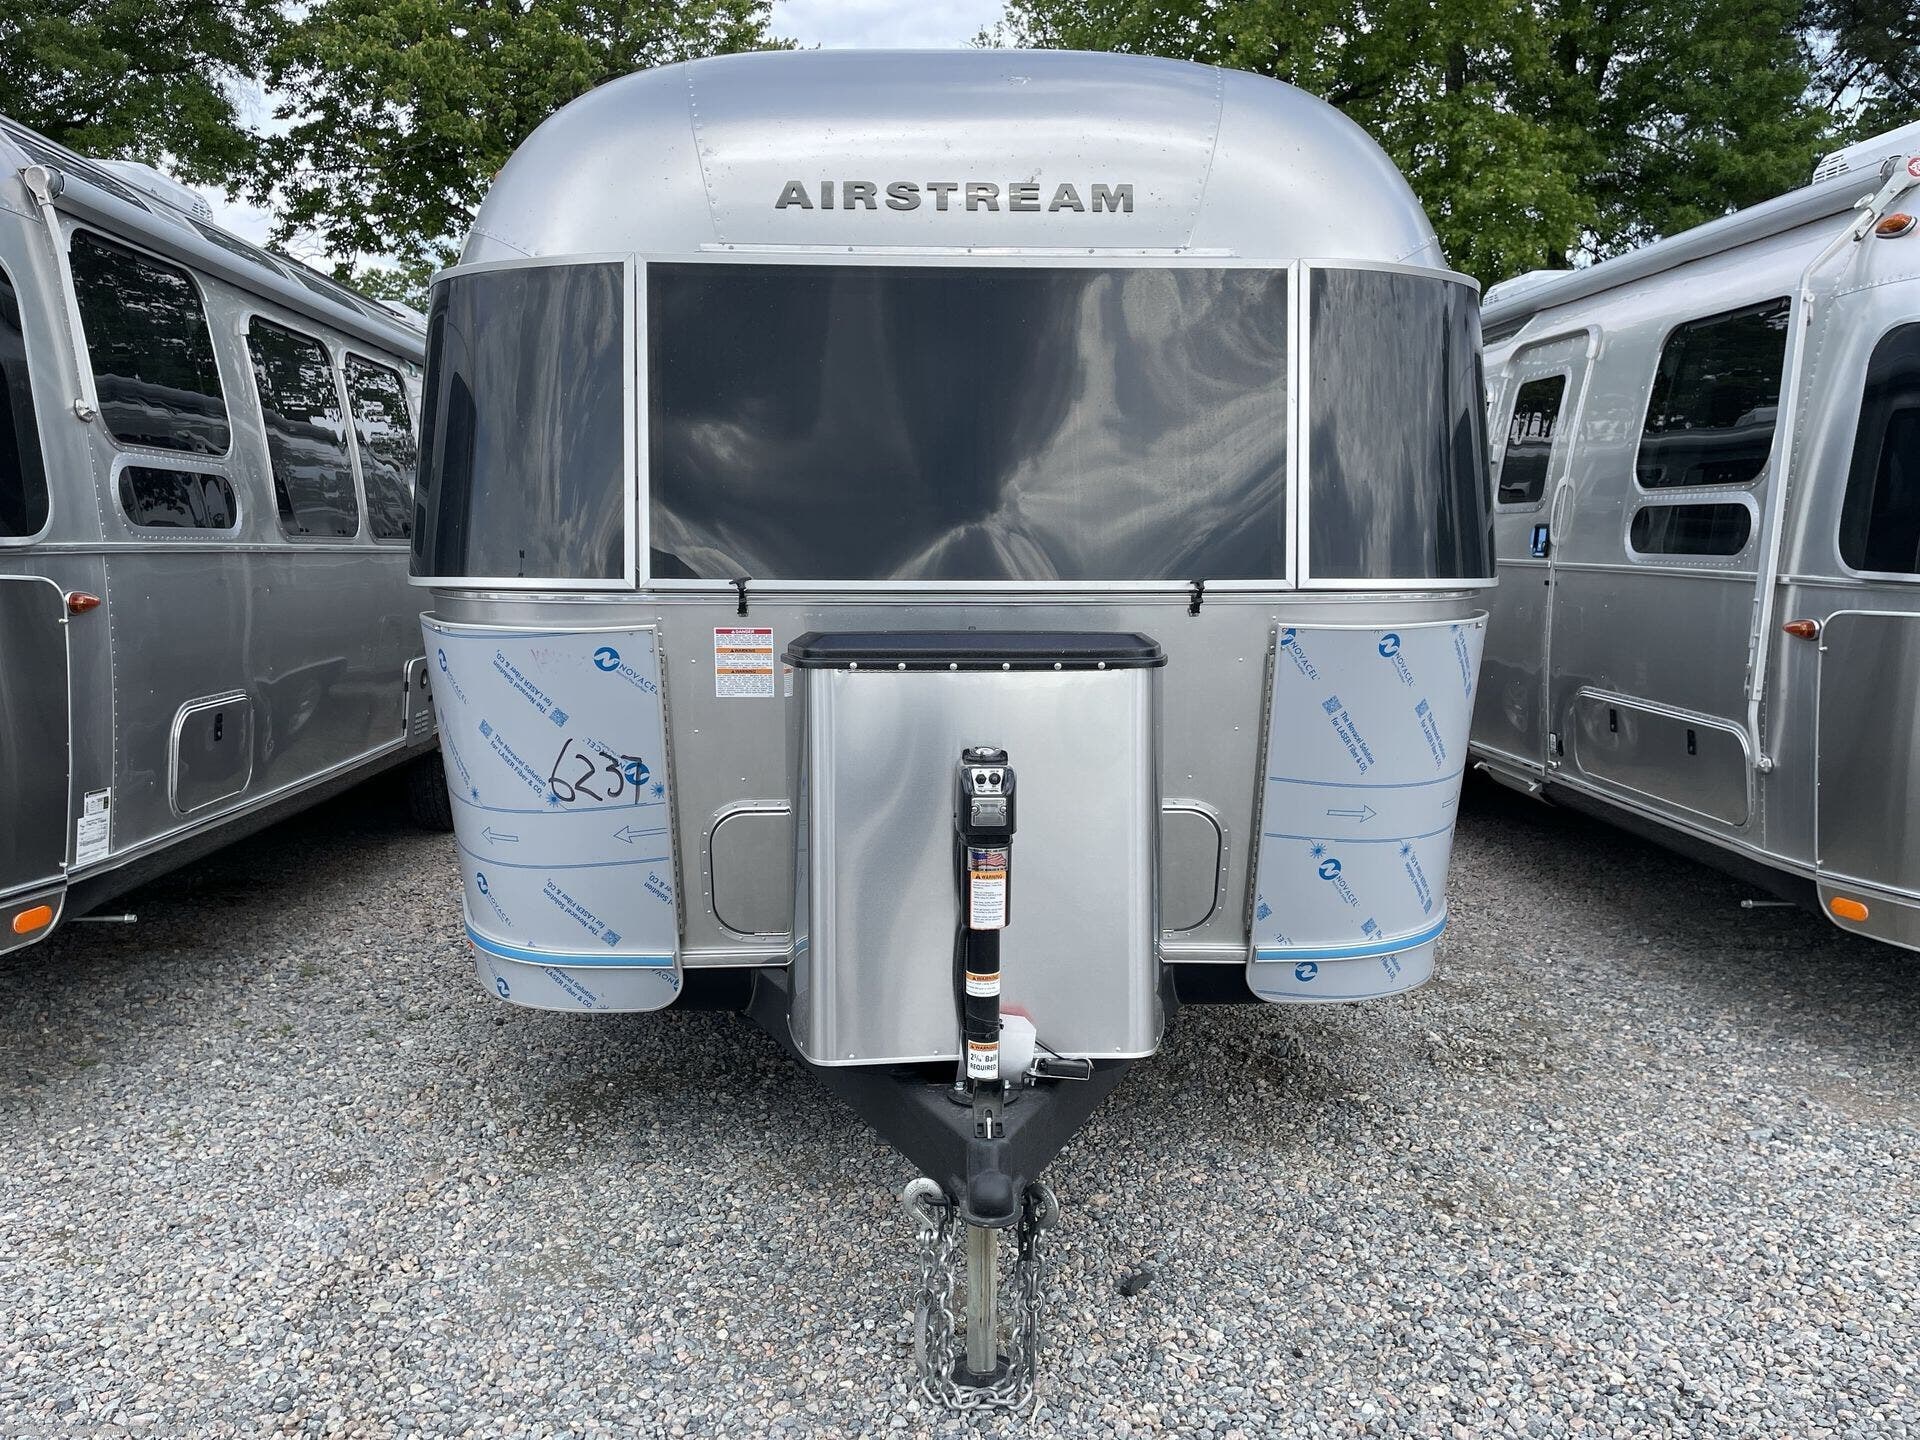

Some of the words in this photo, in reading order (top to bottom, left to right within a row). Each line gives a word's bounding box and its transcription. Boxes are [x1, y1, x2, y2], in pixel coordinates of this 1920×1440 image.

[775, 180, 1133, 213] AIRSTREAM
[493, 660, 514, 684] Solution
[1291, 642, 1318, 680] NOVACEL
[1396, 652, 1414, 687] NOVACEL
[510, 667, 524, 681] Fiber
[619, 664, 658, 695] NOVACEL
[514, 682, 536, 704] Novacel
[524, 680, 543, 699] LASER
[536, 702, 547, 714] The
[544, 697, 552, 706] for
[1331, 716, 1339, 726] for
[1336, 725, 1352, 746] LASER
[1348, 743, 1360, 759] Fiber
[1340, 710, 1349, 723] The
[1347, 721, 1364, 744] Novacel
[1360, 742, 1375, 765] Solution
[490, 741, 498, 750] for
[498, 749, 515, 768] LASER
[514, 766, 528, 781] Fiber
[495, 734, 504, 746] The
[504, 744, 525, 766] Novacel
[524, 765, 547, 787] Solution
[548, 738, 642, 804] 6237
[543, 888, 566, 910] Solution
[562, 894, 576, 908] Fiber
[644, 882, 668, 902] Solution
[1336, 875, 1358, 908] NOVACEL
[488, 892, 511, 927] NOVACEL
[565, 908, 588, 927] Novacel
[576, 905, 596, 922] LASER
[588, 925, 599, 936] The
[596, 921, 606, 929] for
[545, 968, 563, 986] LASER
[563, 983, 578, 997] Fiber
[573, 981, 597, 1002] Solution
[970, 1063, 997, 1071] REQUIRED
[985, 1054, 997, 1062] Ball
